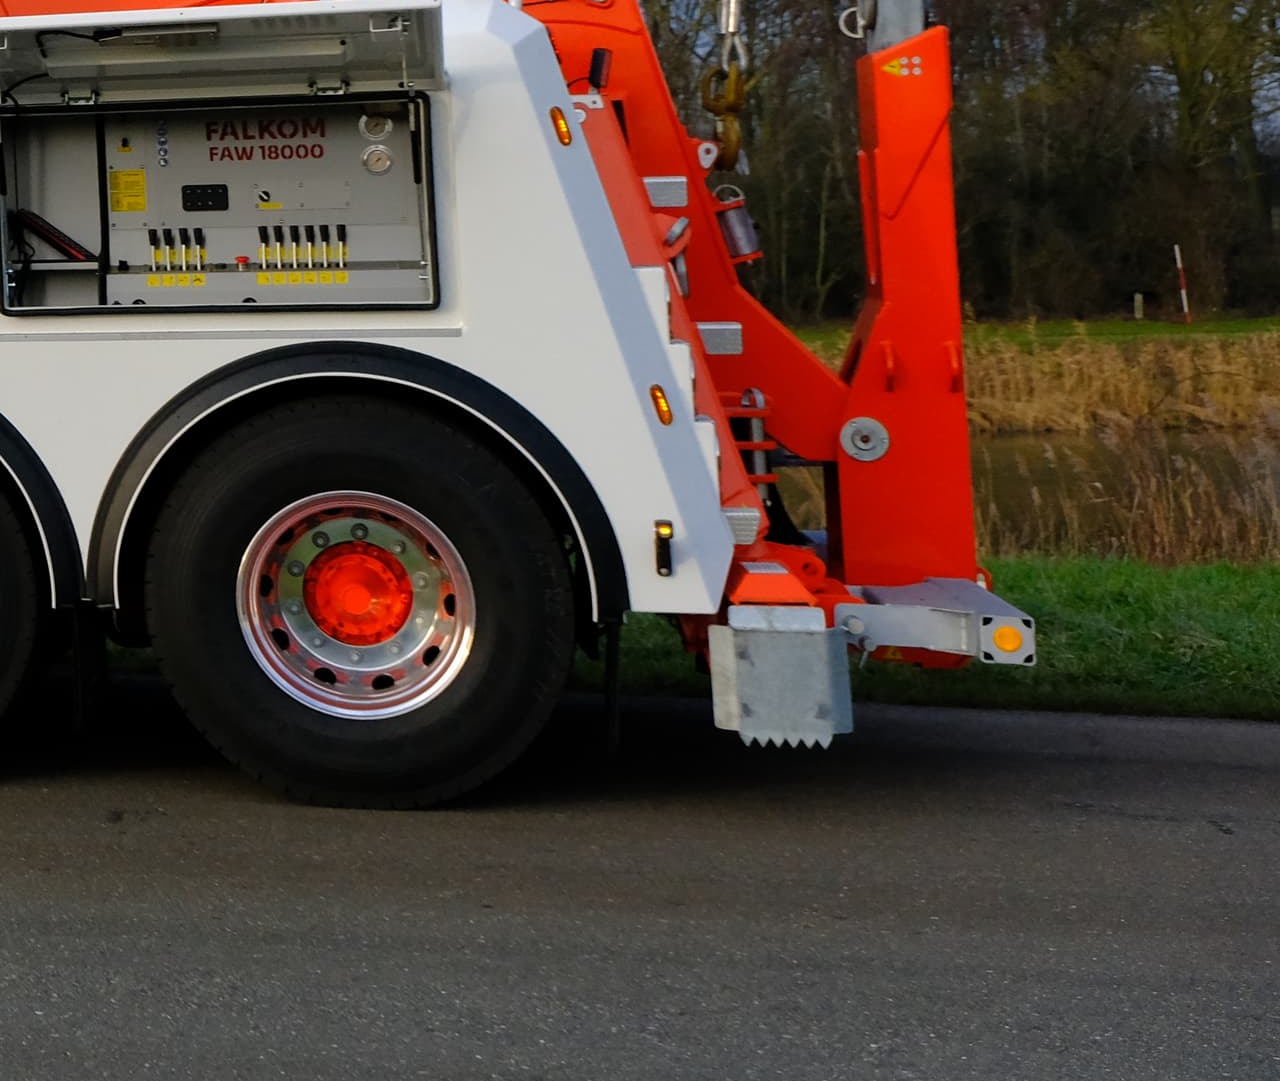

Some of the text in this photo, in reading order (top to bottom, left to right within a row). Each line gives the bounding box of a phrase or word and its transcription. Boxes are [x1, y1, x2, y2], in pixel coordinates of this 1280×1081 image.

[206, 118, 327, 141] FALKOM
[209, 144, 324, 162] FAW 18000
